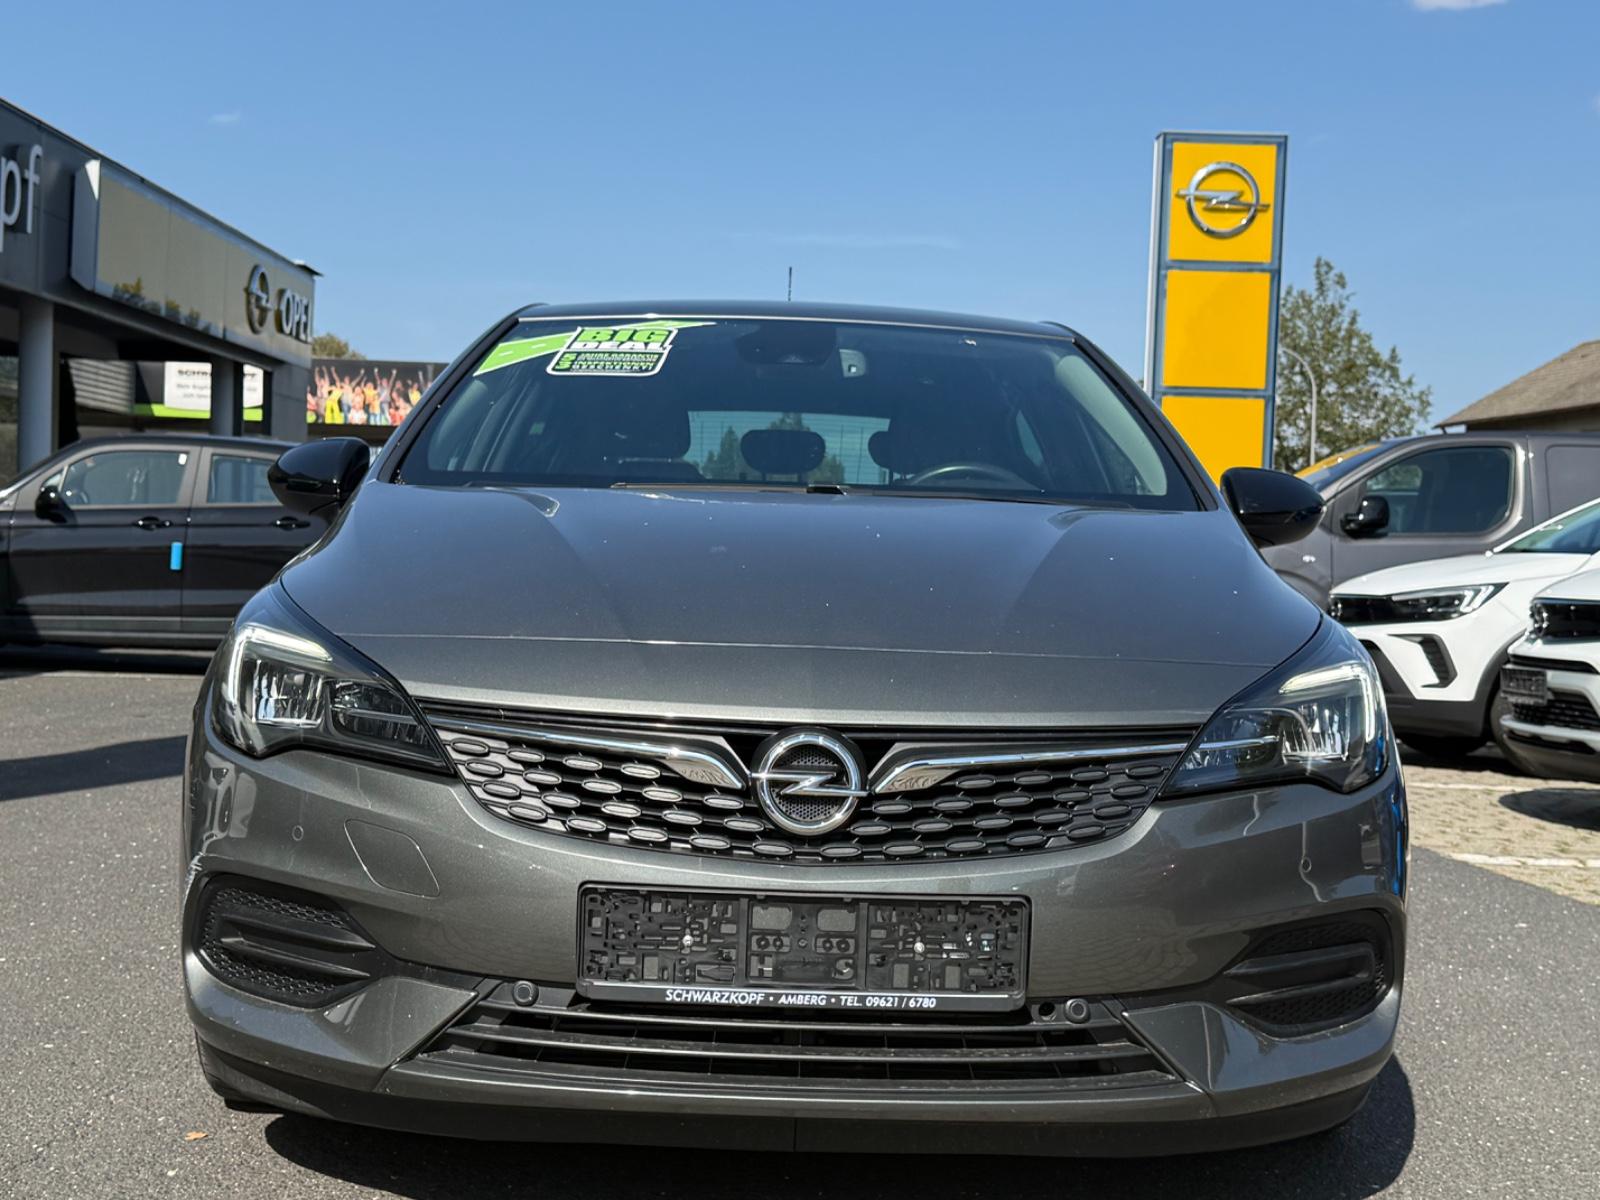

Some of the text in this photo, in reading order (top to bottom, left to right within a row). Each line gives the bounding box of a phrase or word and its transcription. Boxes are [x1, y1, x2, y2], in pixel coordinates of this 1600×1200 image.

[279, 287, 314, 344] OPEL
[577, 329, 669, 342] BIG
[569, 341, 665, 351] DEAL
[665, 989, 765, 1005] SCHWARZKOPF
[778, 994, 828, 1006] AMBERG
[840, 996, 863, 1007] TEL.
[866, 996, 898, 1008] 09621
[909, 997, 936, 1009] 6780
